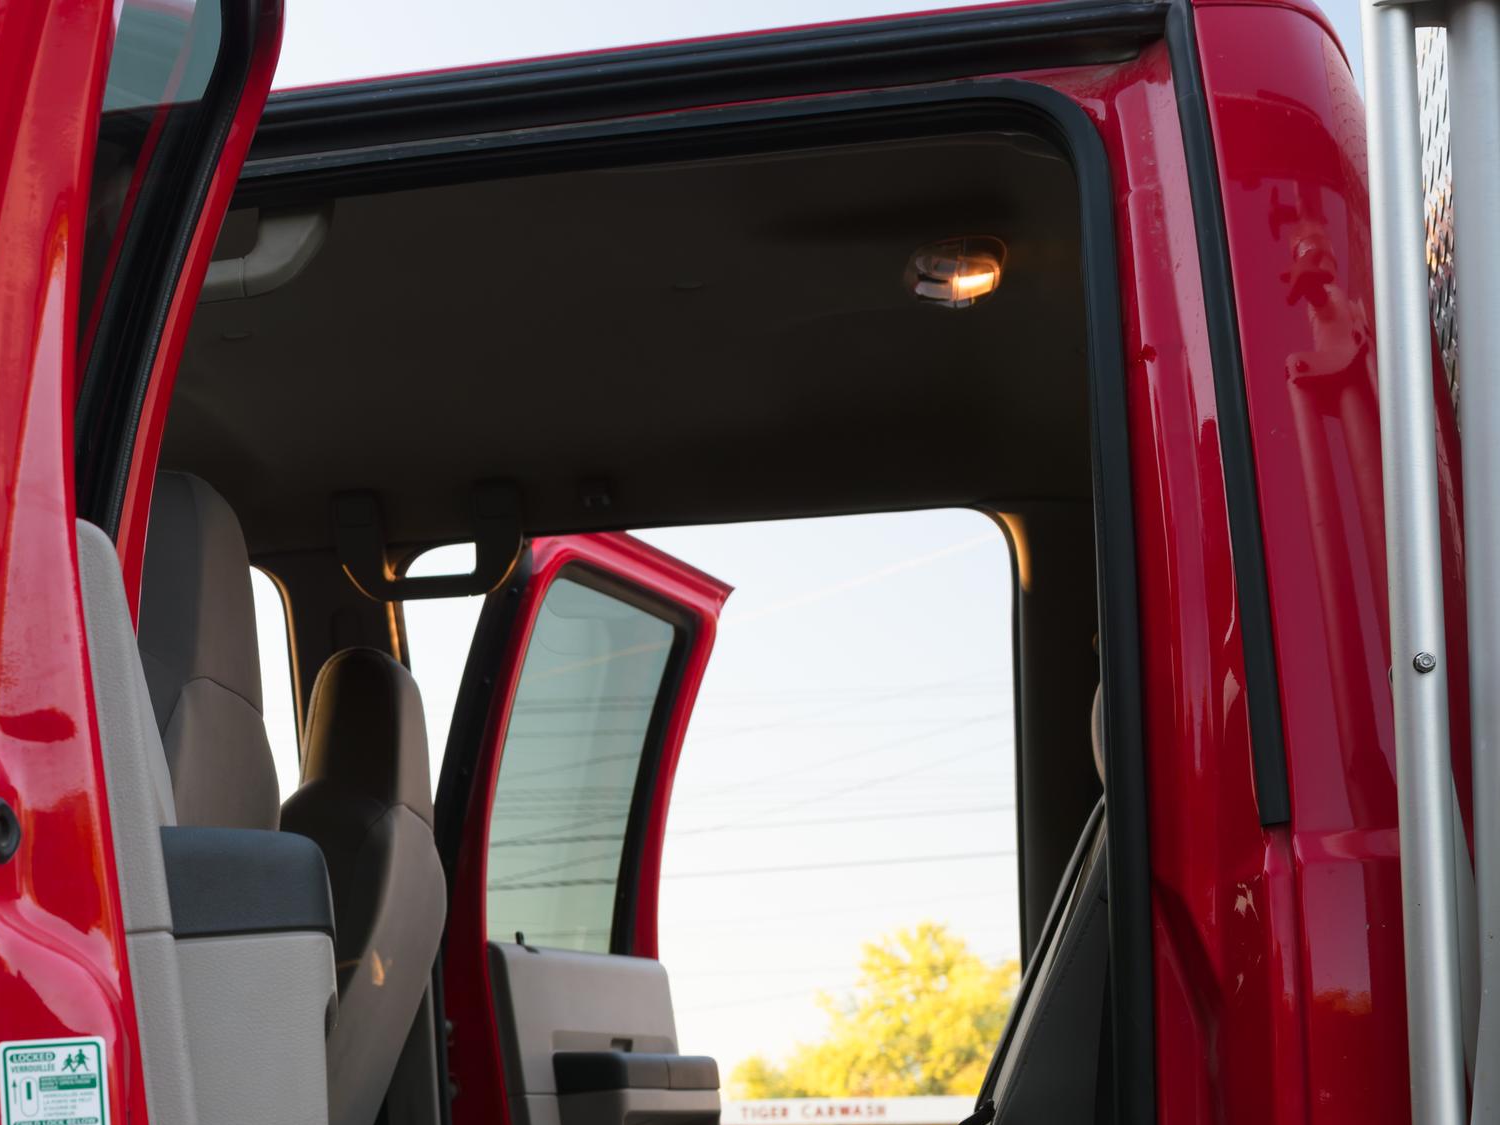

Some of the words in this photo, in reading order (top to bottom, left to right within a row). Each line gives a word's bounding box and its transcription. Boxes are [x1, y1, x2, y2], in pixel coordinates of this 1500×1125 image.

[12, 1052, 53, 1063] LOCKED
[740, 1106, 789, 1119] TIGER
[801, 1104, 887, 1118] CARWASH
[67, 1117, 96, 1125] BELOW
